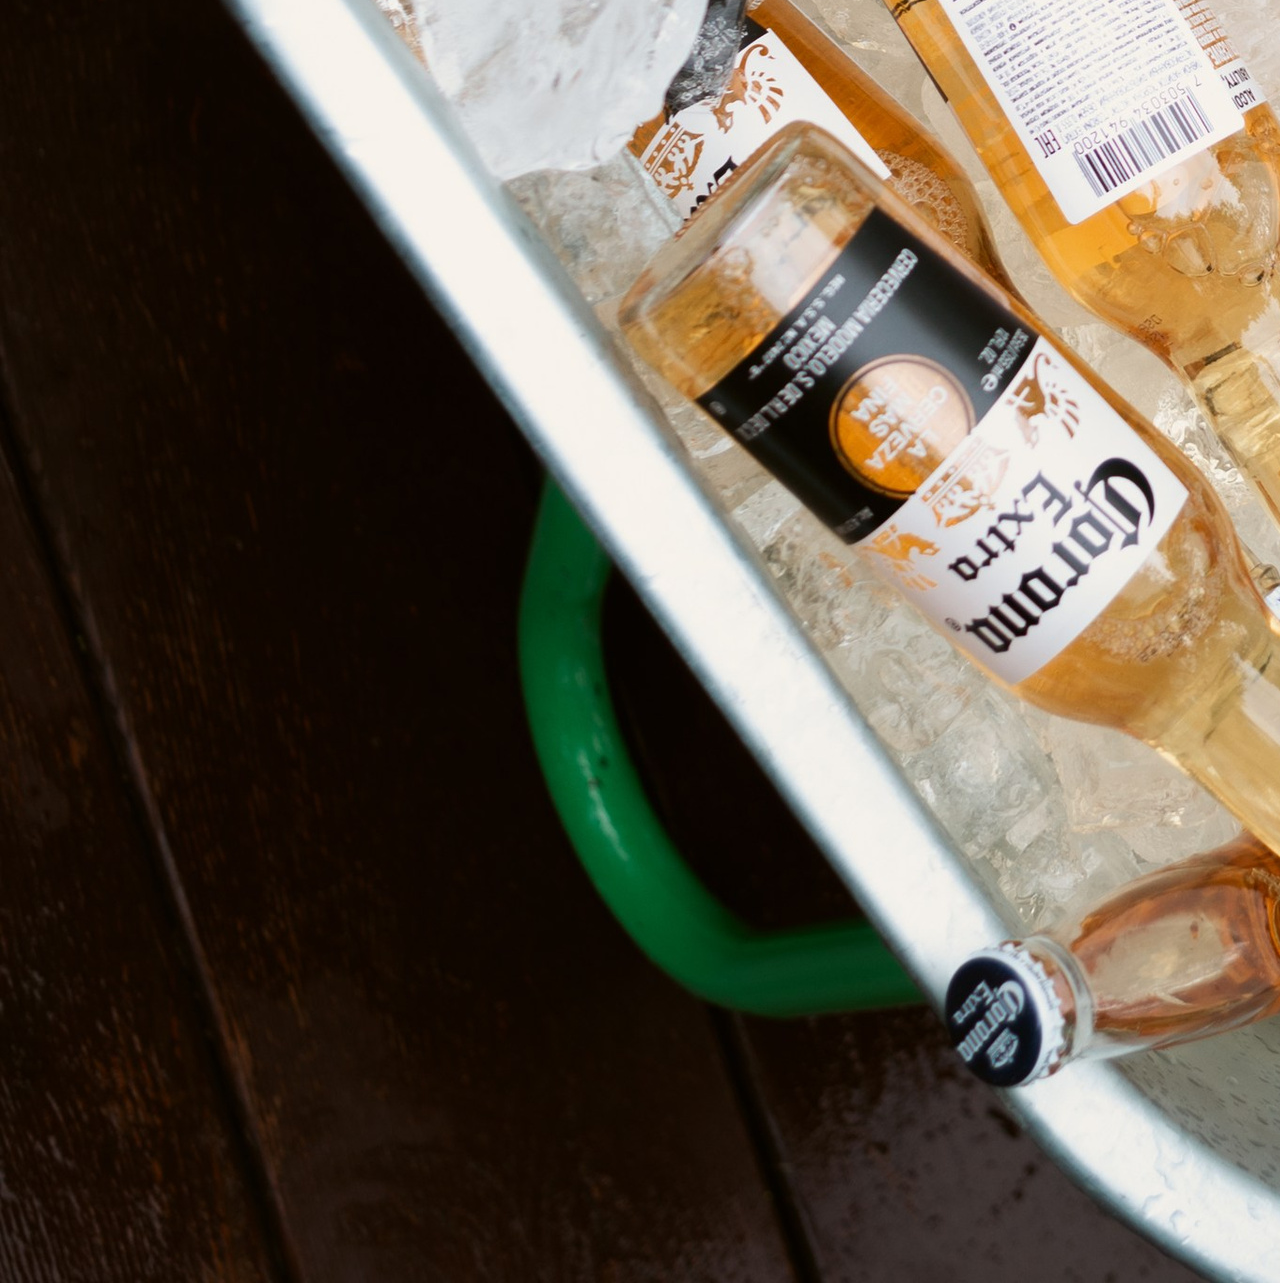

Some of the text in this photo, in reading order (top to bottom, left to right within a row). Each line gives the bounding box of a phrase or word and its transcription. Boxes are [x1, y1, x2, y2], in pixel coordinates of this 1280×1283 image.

[1070, 114, 1130, 157] 941200
[808, 248, 918, 375] CERVECERIA MODELO,
[783, 314, 838, 369] MEXICO
[849, 373, 900, 426] FINA
[865, 389, 916, 441] MAS
[863, 384, 949, 473] CERVEZA
[904, 426, 941, 462] LA
[948, 474, 1072, 581] Extra
[964, 458, 1154, 653] Corona
